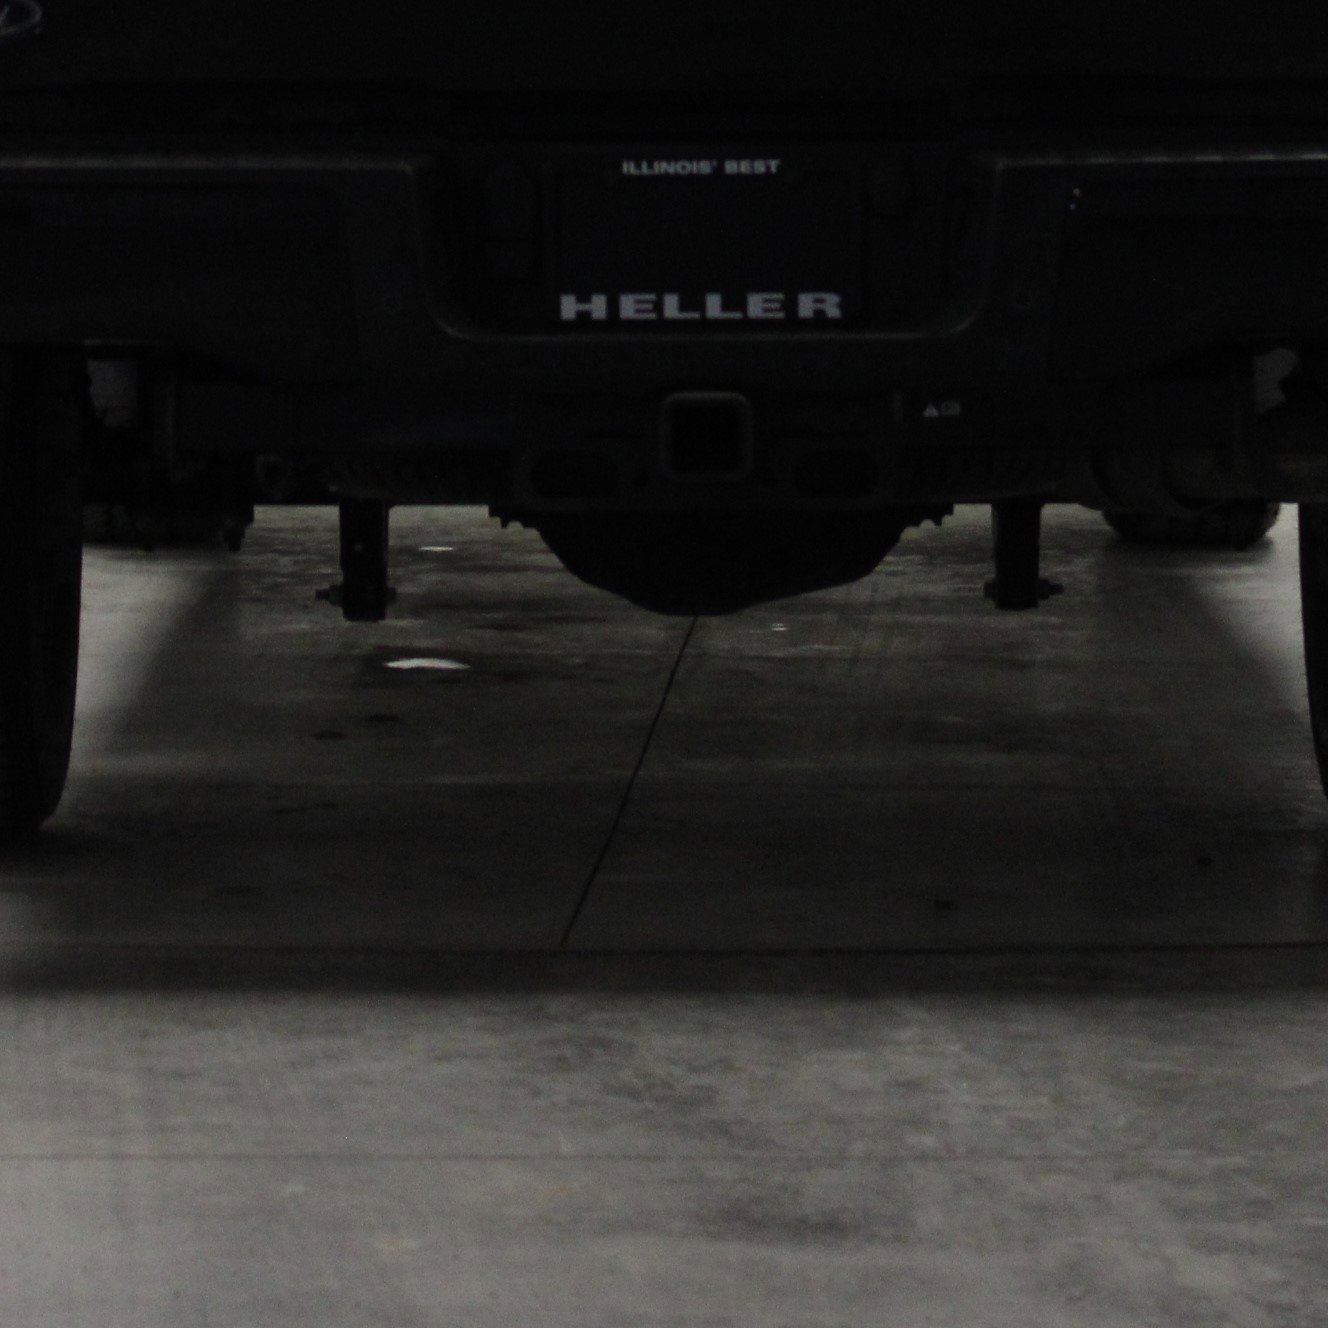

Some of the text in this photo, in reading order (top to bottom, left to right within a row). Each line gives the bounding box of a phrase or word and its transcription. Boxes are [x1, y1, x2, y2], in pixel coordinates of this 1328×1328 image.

[622, 158, 782, 176] ILLINOIS' BEST
[559, 291, 843, 321] HELLER
